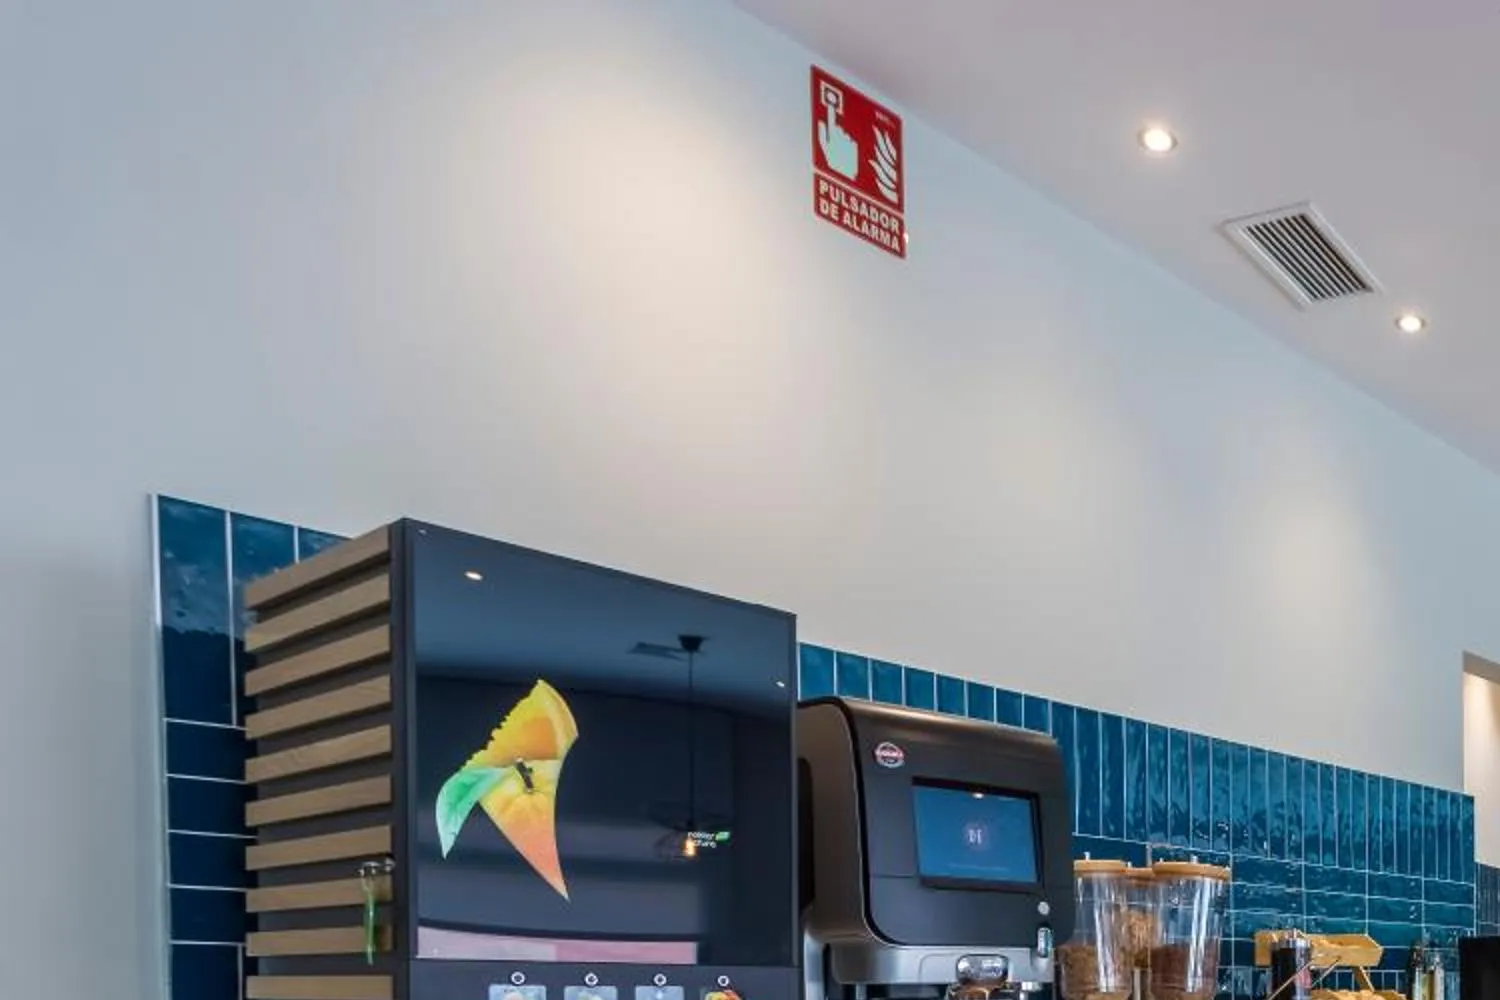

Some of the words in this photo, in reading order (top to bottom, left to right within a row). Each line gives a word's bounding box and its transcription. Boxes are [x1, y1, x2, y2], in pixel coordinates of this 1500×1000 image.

[819, 180, 899, 233] PULSADOR
[819, 198, 839, 220] DE
[843, 211, 900, 250] ALARMA
